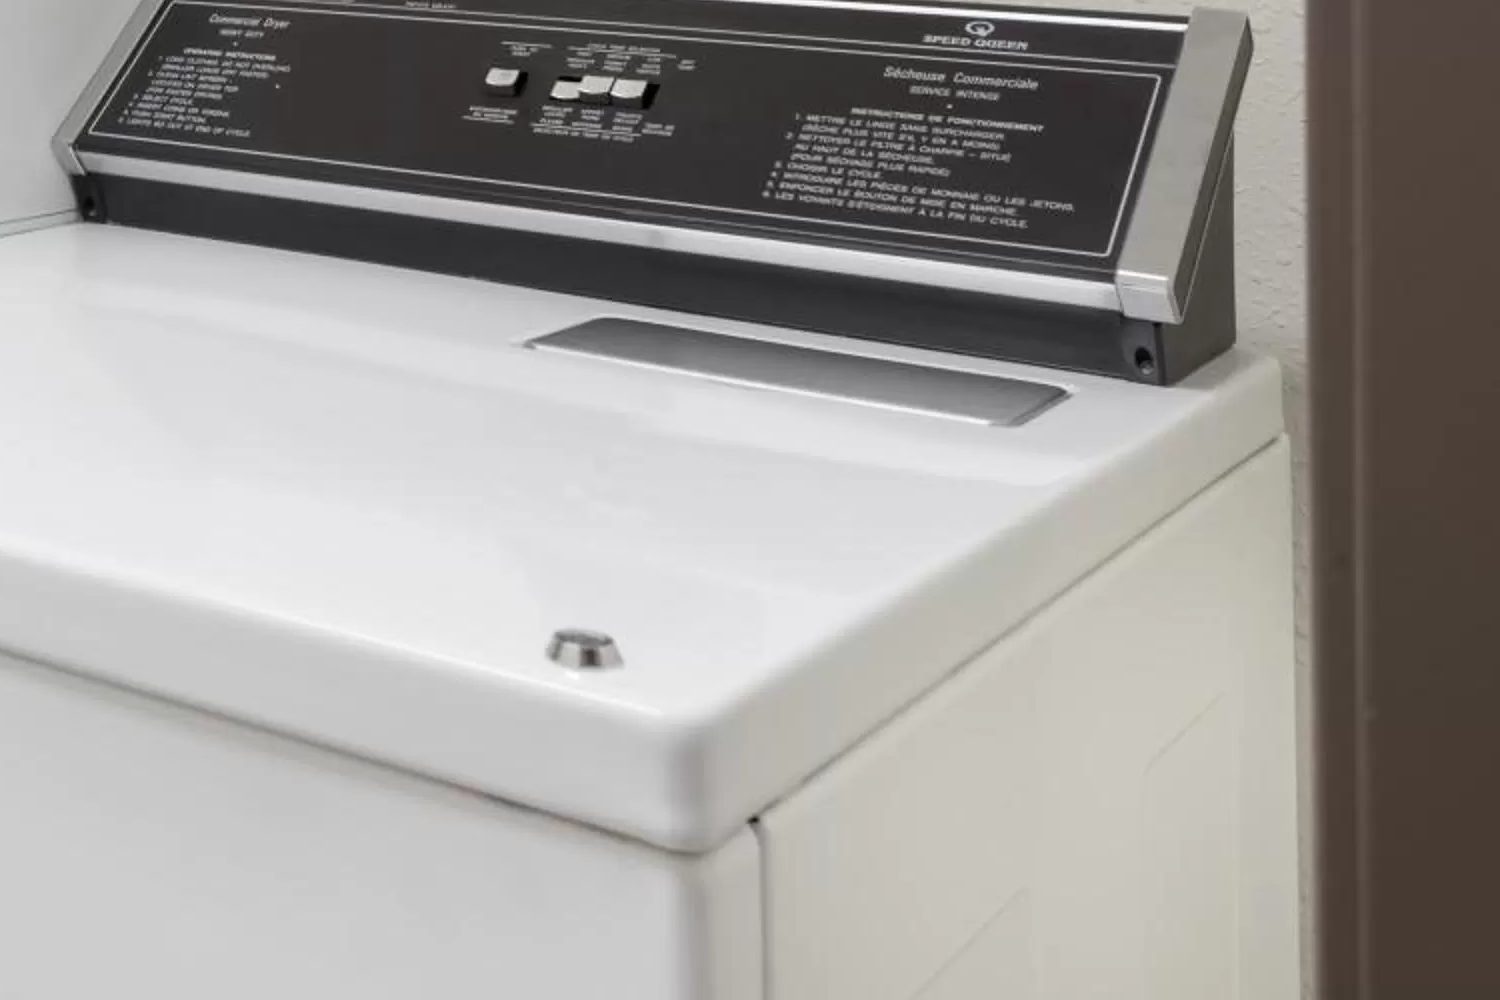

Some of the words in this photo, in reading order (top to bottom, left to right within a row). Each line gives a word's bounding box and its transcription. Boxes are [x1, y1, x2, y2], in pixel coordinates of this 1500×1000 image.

[263, 18, 290, 29] Dryer
[922, 34, 972, 47] SPEED
[973, 39, 1029, 51] QUEEN
[883, 66, 947, 82] Sécheuse
[953, 73, 1039, 91] Commerciale
[909, 86, 951, 97] SERVICE
[955, 90, 1000, 101] INTENSE
[805, 114, 846, 125] METTRE
[849, 119, 862, 127] LE
[947, 117, 1044, 133] FONCTIONNEMENT
[798, 134, 851, 145] NETTOYER
[853, 139, 867, 147] LE
[871, 131, 895, 140] VITE
[812, 145, 840, 154] HAUT
[842, 148, 856, 156] DE
[831, 167, 845, 175] LE
[837, 189, 850, 197] LE
[949, 201, 967, 209] EN
[983, 194, 1001, 203] OU
[1004, 197, 1027, 206] LES
[775, 192, 795, 201] LES
[929, 210, 944, 218] LA
[947, 212, 967, 220] FIN
